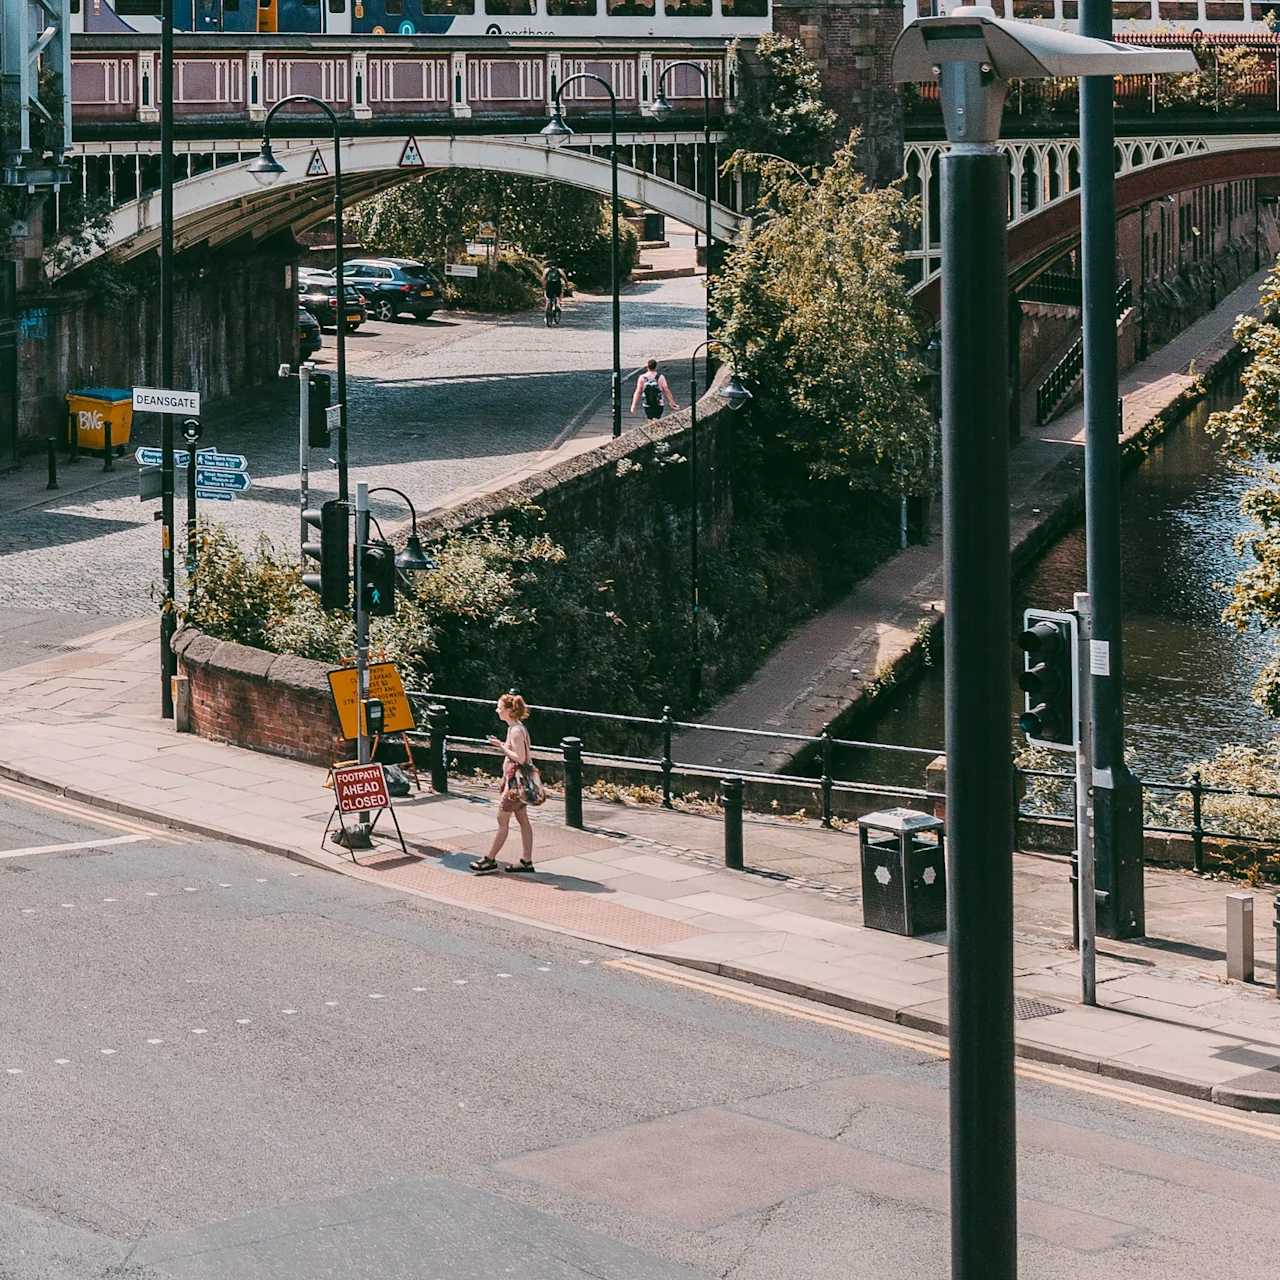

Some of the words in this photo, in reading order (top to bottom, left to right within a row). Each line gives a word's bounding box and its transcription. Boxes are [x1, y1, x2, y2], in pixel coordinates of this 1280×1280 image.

[136, 394, 197, 409] DEANSGATE
[337, 770, 380, 784] FOOTPATH
[342, 781, 380, 797] AHEAD
[341, 794, 386, 810] CLOSED
